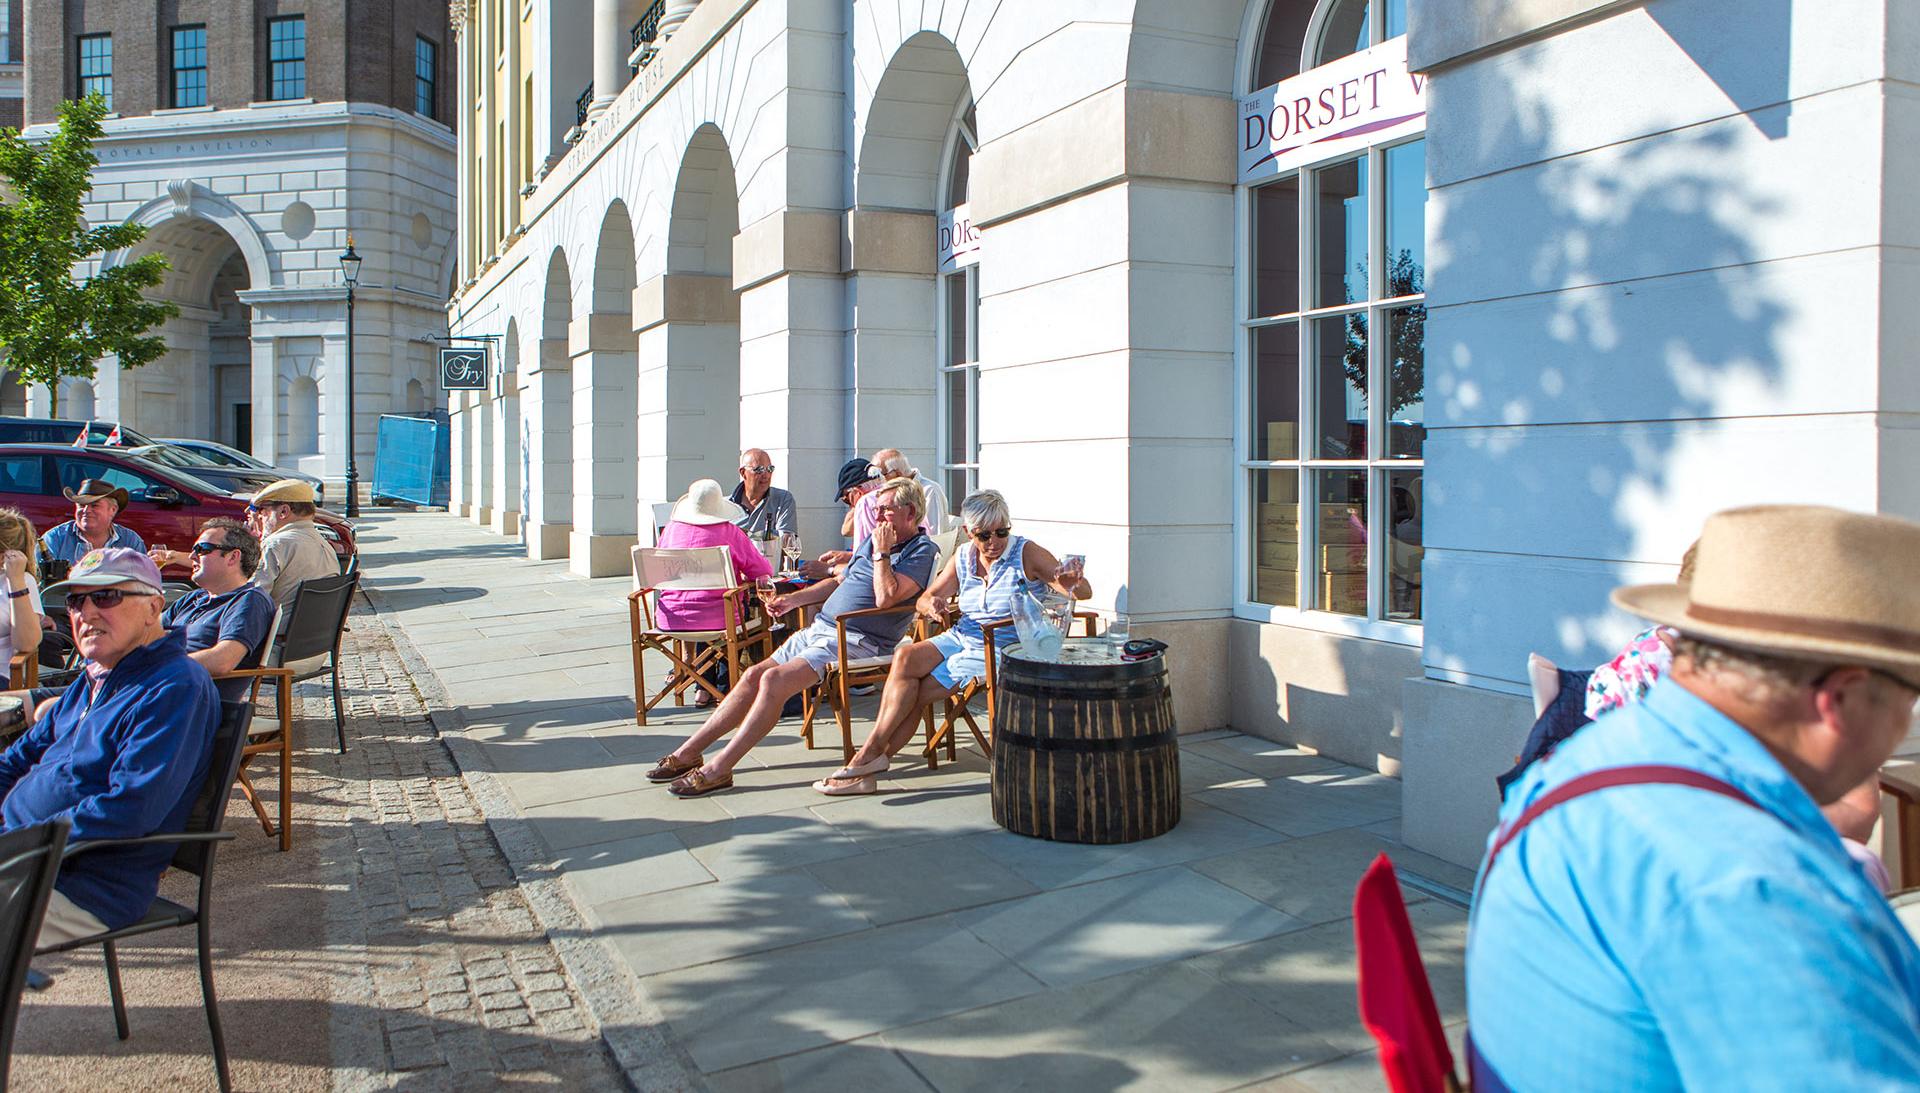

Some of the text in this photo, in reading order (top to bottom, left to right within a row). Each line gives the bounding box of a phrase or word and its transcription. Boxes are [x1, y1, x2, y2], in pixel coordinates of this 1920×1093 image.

[629, 57, 664, 112] HOUSE
[1244, 99, 1260, 113] THE
[1244, 68, 1387, 151] DORSET
[97, 139, 273, 159] ROYAL PAVILION
[445, 354, 483, 384] Fry
